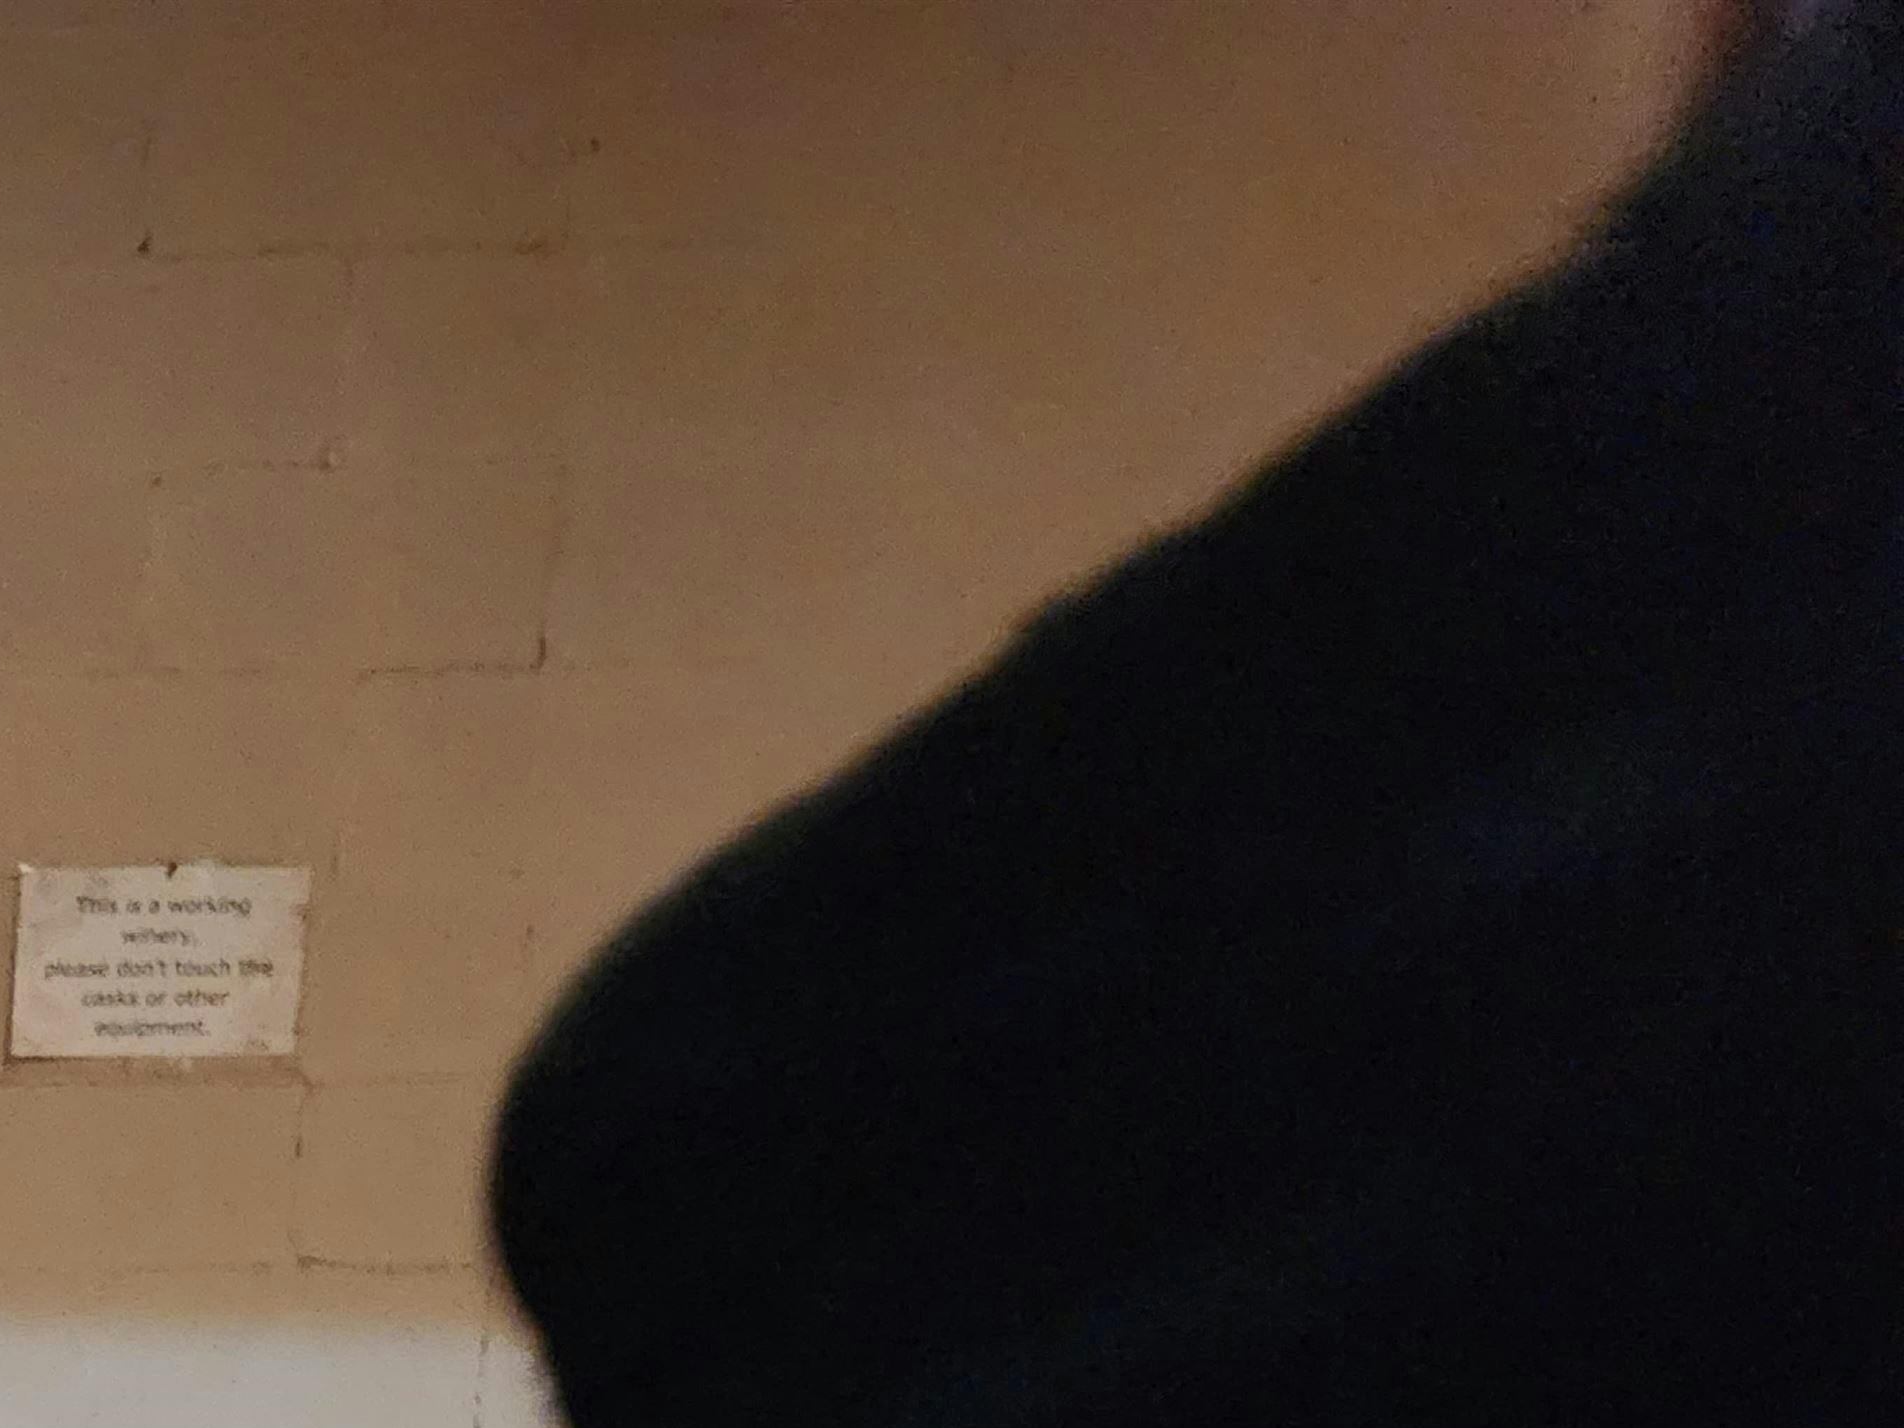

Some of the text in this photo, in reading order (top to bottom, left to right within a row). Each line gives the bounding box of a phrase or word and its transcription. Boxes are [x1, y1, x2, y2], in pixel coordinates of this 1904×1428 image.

[75, 895, 253, 918] This is a working
[43, 960, 109, 981] please
[174, 958, 231, 978] touch
[144, 991, 168, 1008] or
[174, 988, 231, 1008] other
